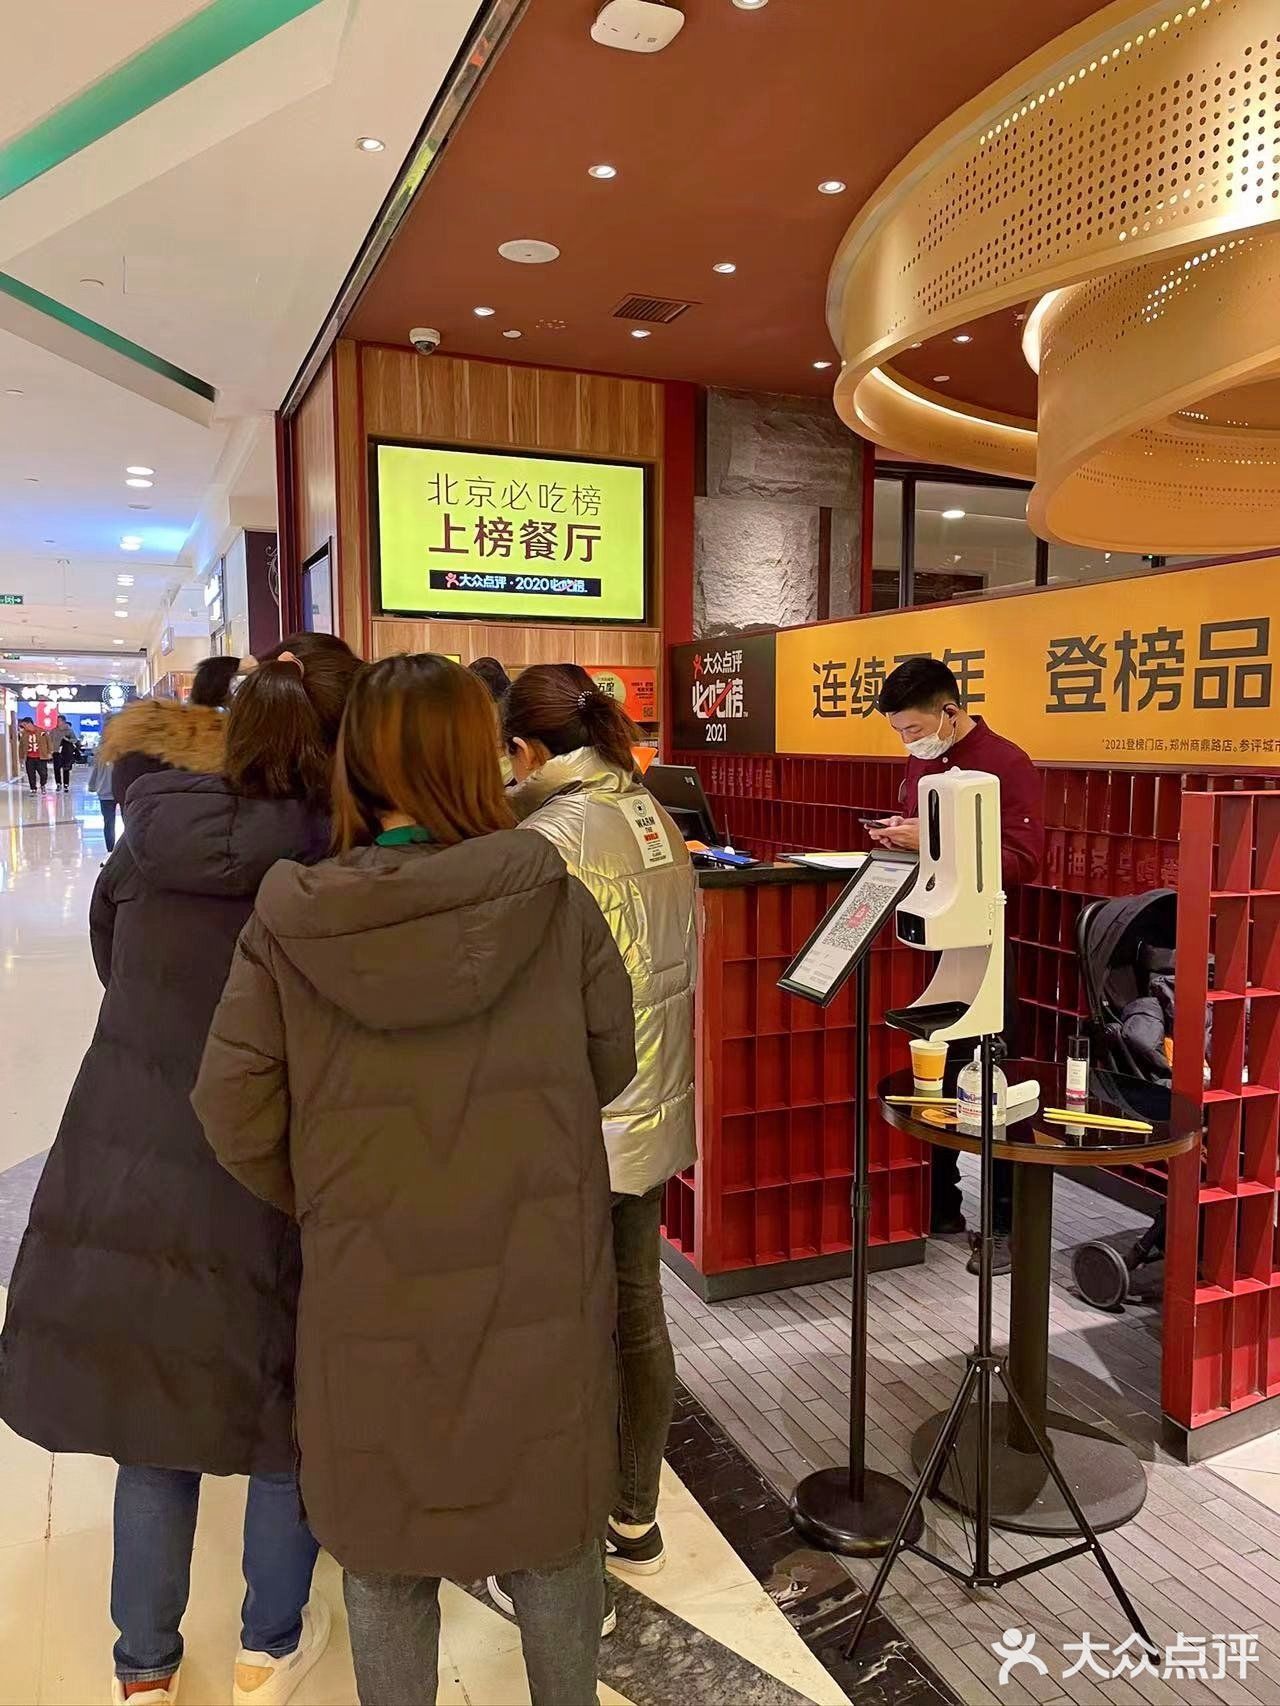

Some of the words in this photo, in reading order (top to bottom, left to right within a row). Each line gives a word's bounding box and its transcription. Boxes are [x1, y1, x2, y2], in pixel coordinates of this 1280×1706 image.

[427, 472, 601, 516] 北京必吃榜
[428, 513, 601, 562] 上榜餐厅
[703, 650, 743, 675] 大众点评
[813, 648, 985, 718] 连续年
[1046, 617, 1272, 713] 登榜品
[692, 678, 743, 718] 必吃榜
[705, 723, 727, 742] 2021
